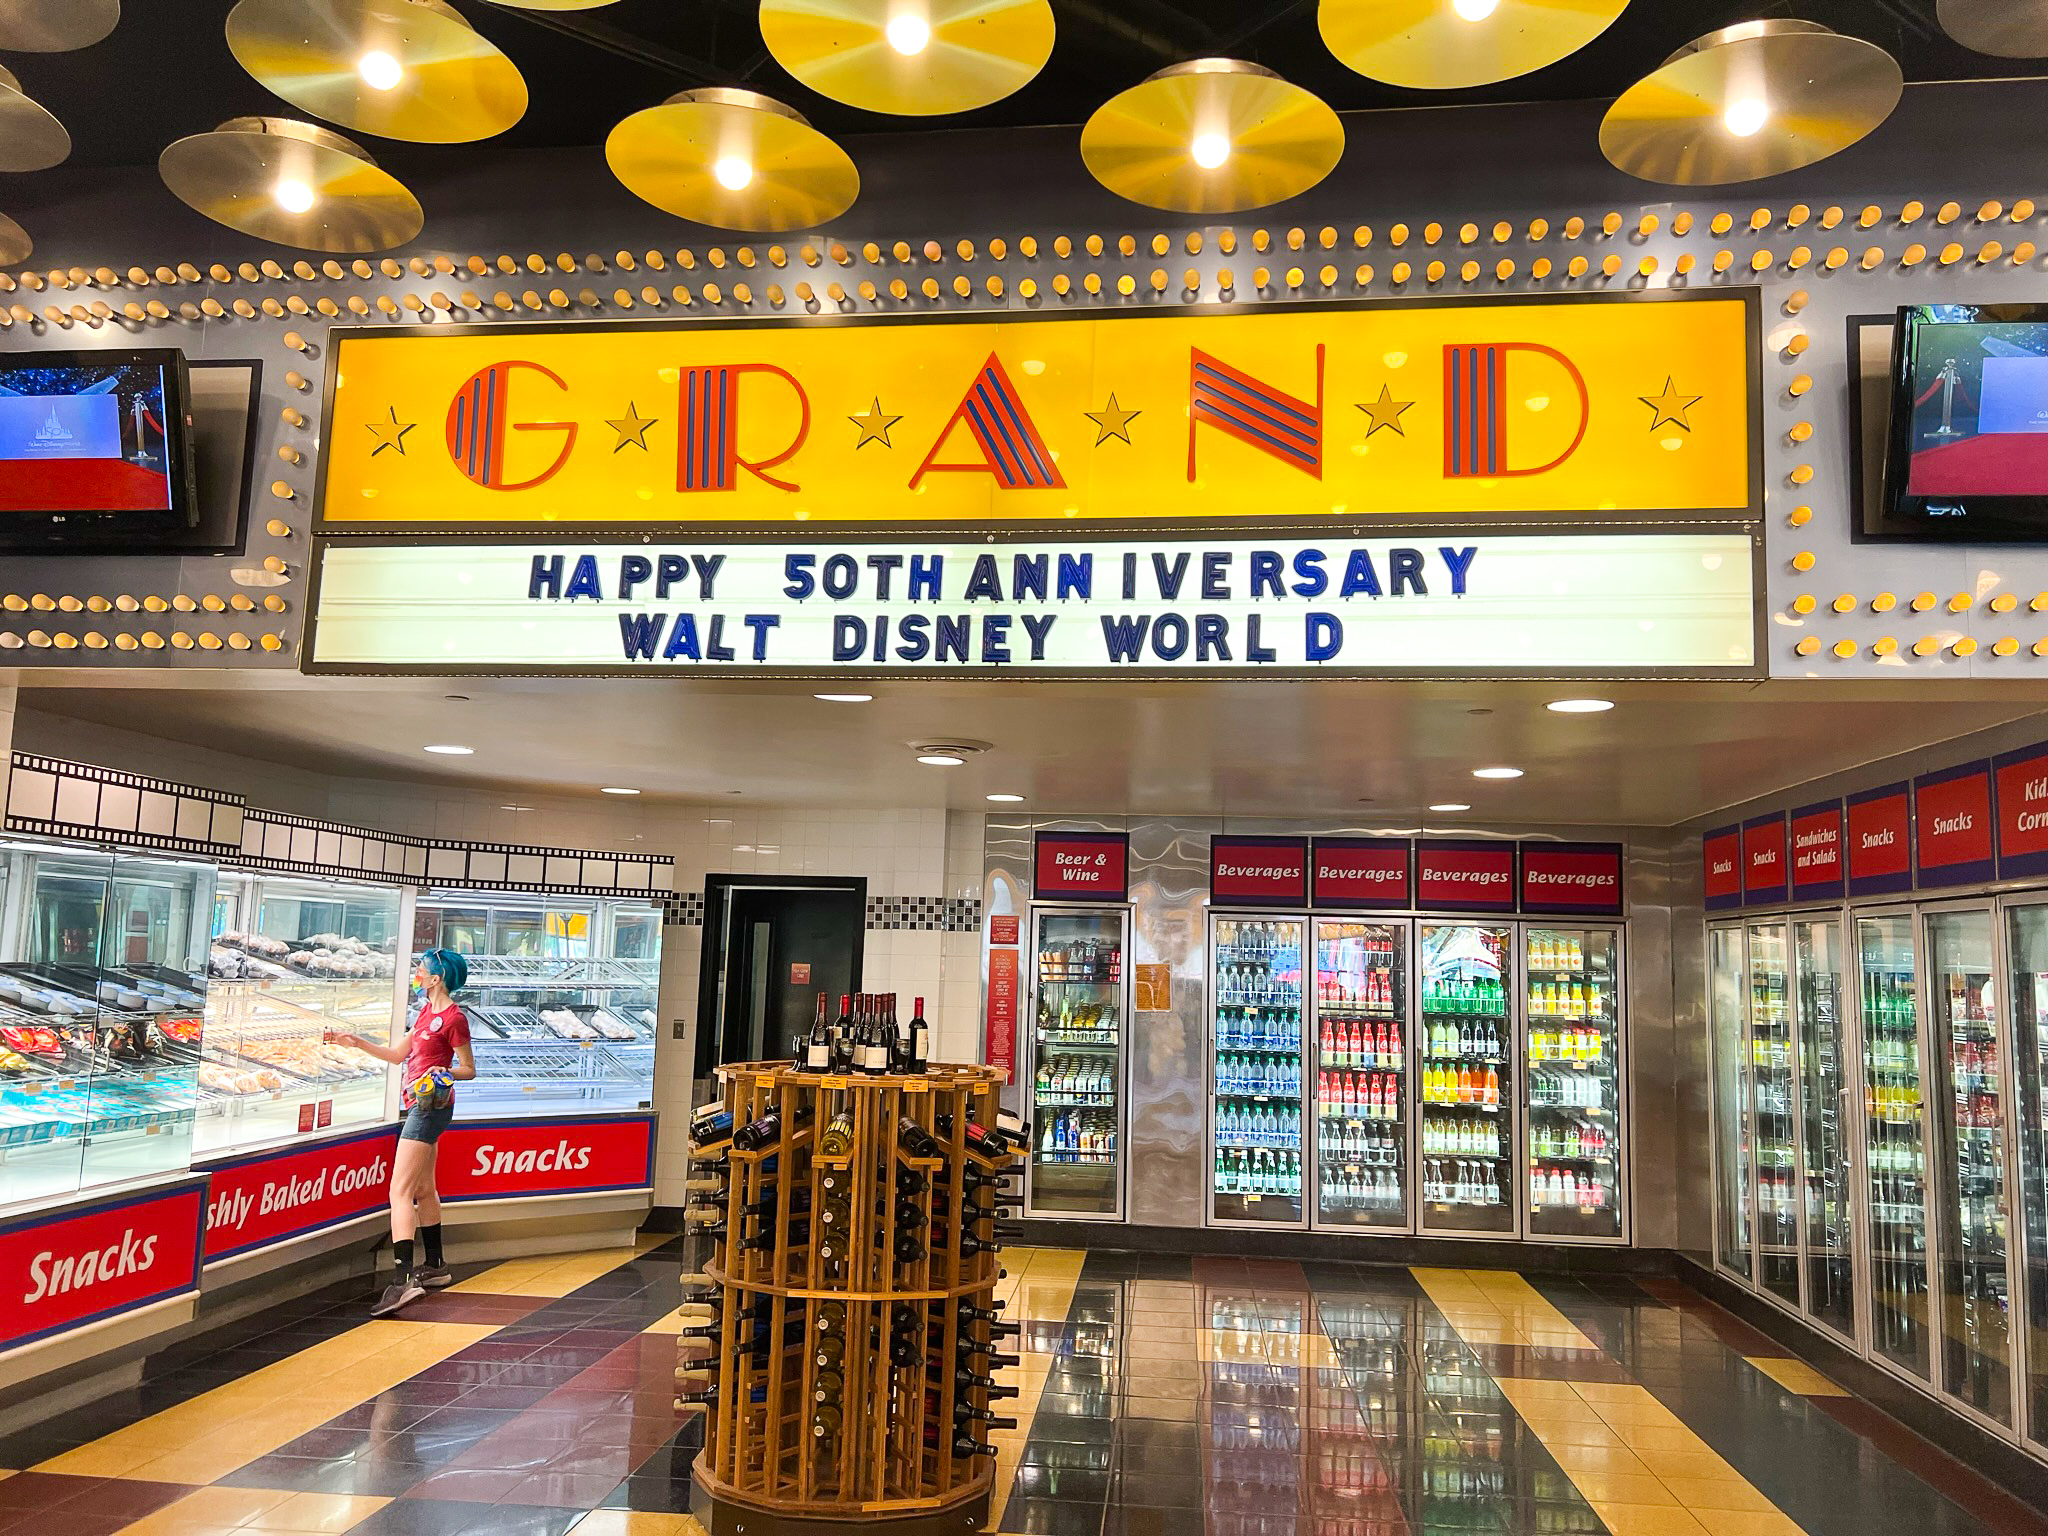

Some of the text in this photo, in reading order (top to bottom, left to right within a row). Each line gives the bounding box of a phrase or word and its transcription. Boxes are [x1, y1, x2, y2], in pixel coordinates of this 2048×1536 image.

[445, 342, 1589, 493] GRAND
[528, 554, 727, 602] HAPPY
[782, 553, 944, 602] 50TH
[619, 612, 1344, 663] WALT DISNEY WORLD
[2025, 776, 2048, 802] Kid
[1933, 812, 1973, 835] Snacks
[1796, 828, 1837, 849] Sandwiches
[1862, 828, 1894, 849] Snacks
[1055, 852, 1107, 866] Beer &
[1713, 859, 1732, 874] Snacks
[1753, 849, 1776, 866] Snacks
[1797, 847, 1837, 868] and Salads
[1063, 868, 1100, 881] Wine
[1217, 863, 1300, 880] Beverages
[1319, 866, 1404, 882] Beverages
[1422, 868, 1508, 885] Beverages
[1528, 871, 1615, 888] Beverages
[471, 1140, 592, 1176] Snacks
[259, 1167, 328, 1215] Baked
[331, 1155, 387, 1196] Goods
[24, 1228, 158, 1304] Snacks
